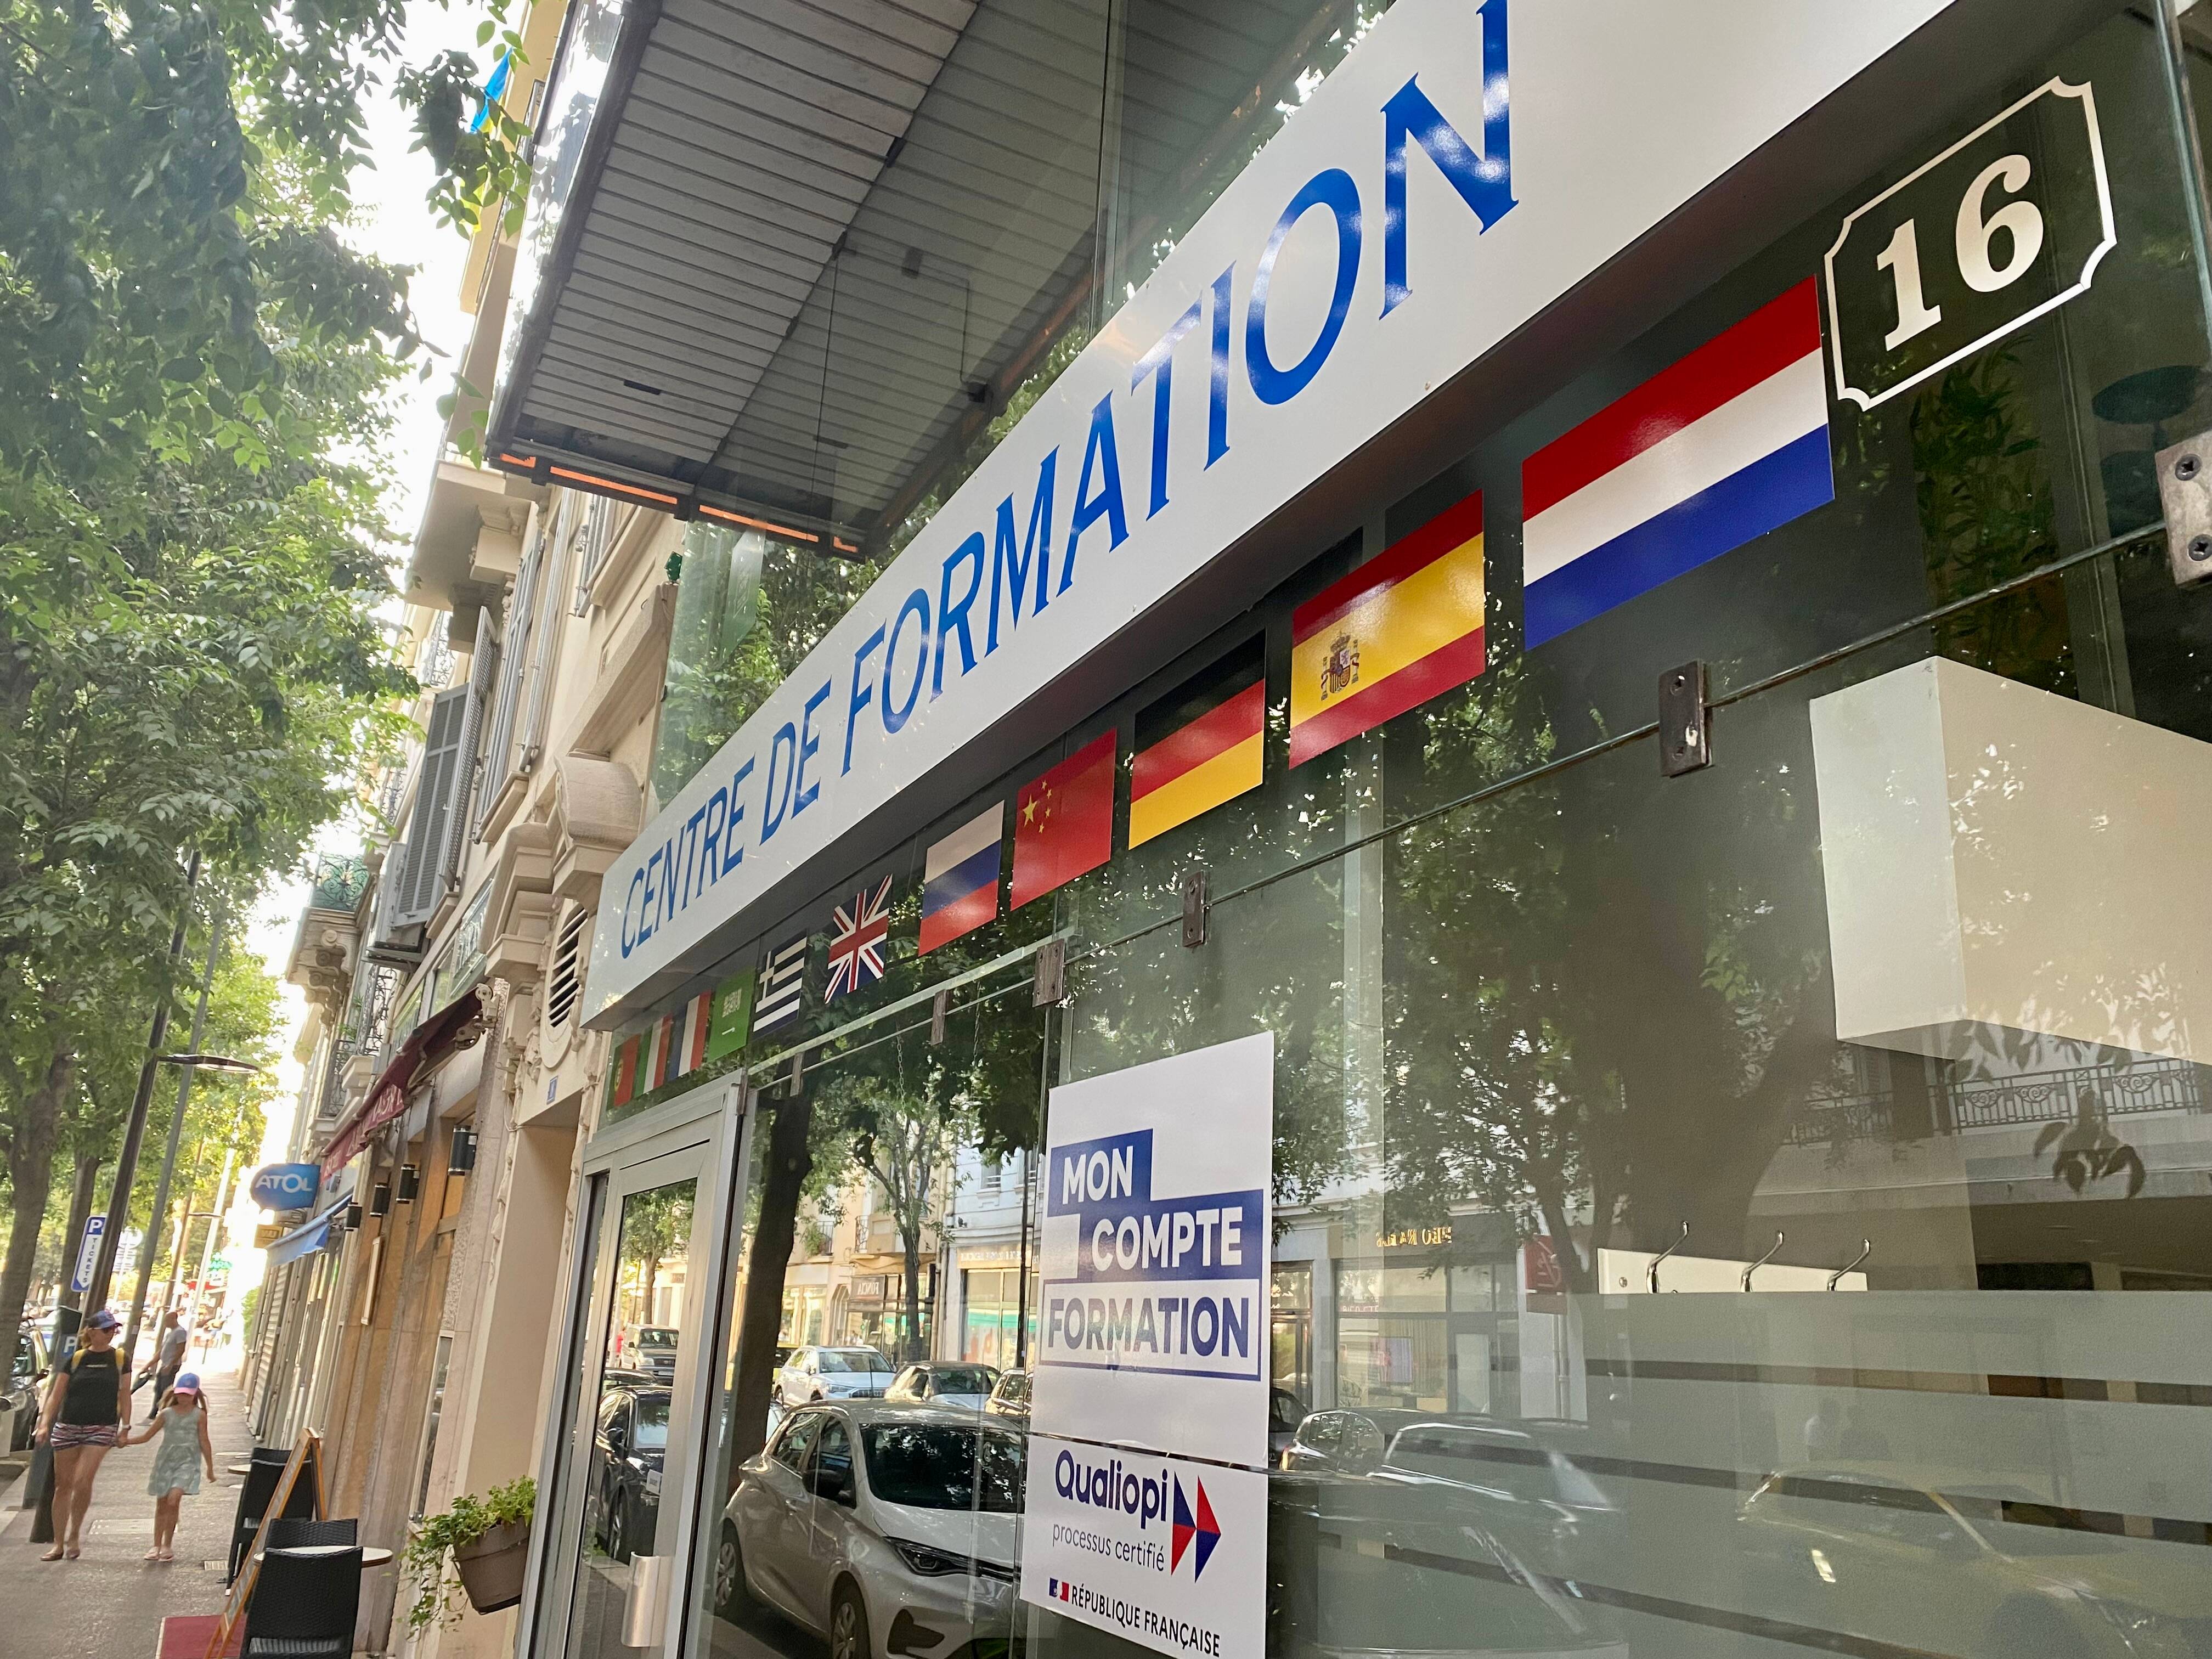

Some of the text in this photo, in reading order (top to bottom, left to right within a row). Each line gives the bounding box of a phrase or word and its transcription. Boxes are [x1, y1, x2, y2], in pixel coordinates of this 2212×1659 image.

[1877, 154, 2044, 351] 16
[620, 0, 1519, 959] CENTRE DE FORMATION
[255, 1173, 313, 1193] ATOL
[1062, 1146, 1134, 1205] MON
[88, 1219, 103, 1233] P
[1091, 1206, 1243, 1272] COMPTE
[83, 1238, 98, 1283] TICKETS
[1048, 1296, 1249, 1358] FORMATION
[1055, 1449, 1167, 1530] Qualiopi
[1052, 1522, 1165, 1572] processus certifié
[1071, 1583, 1220, 1658] RÉPUBLIQUE FRANÇAISE
